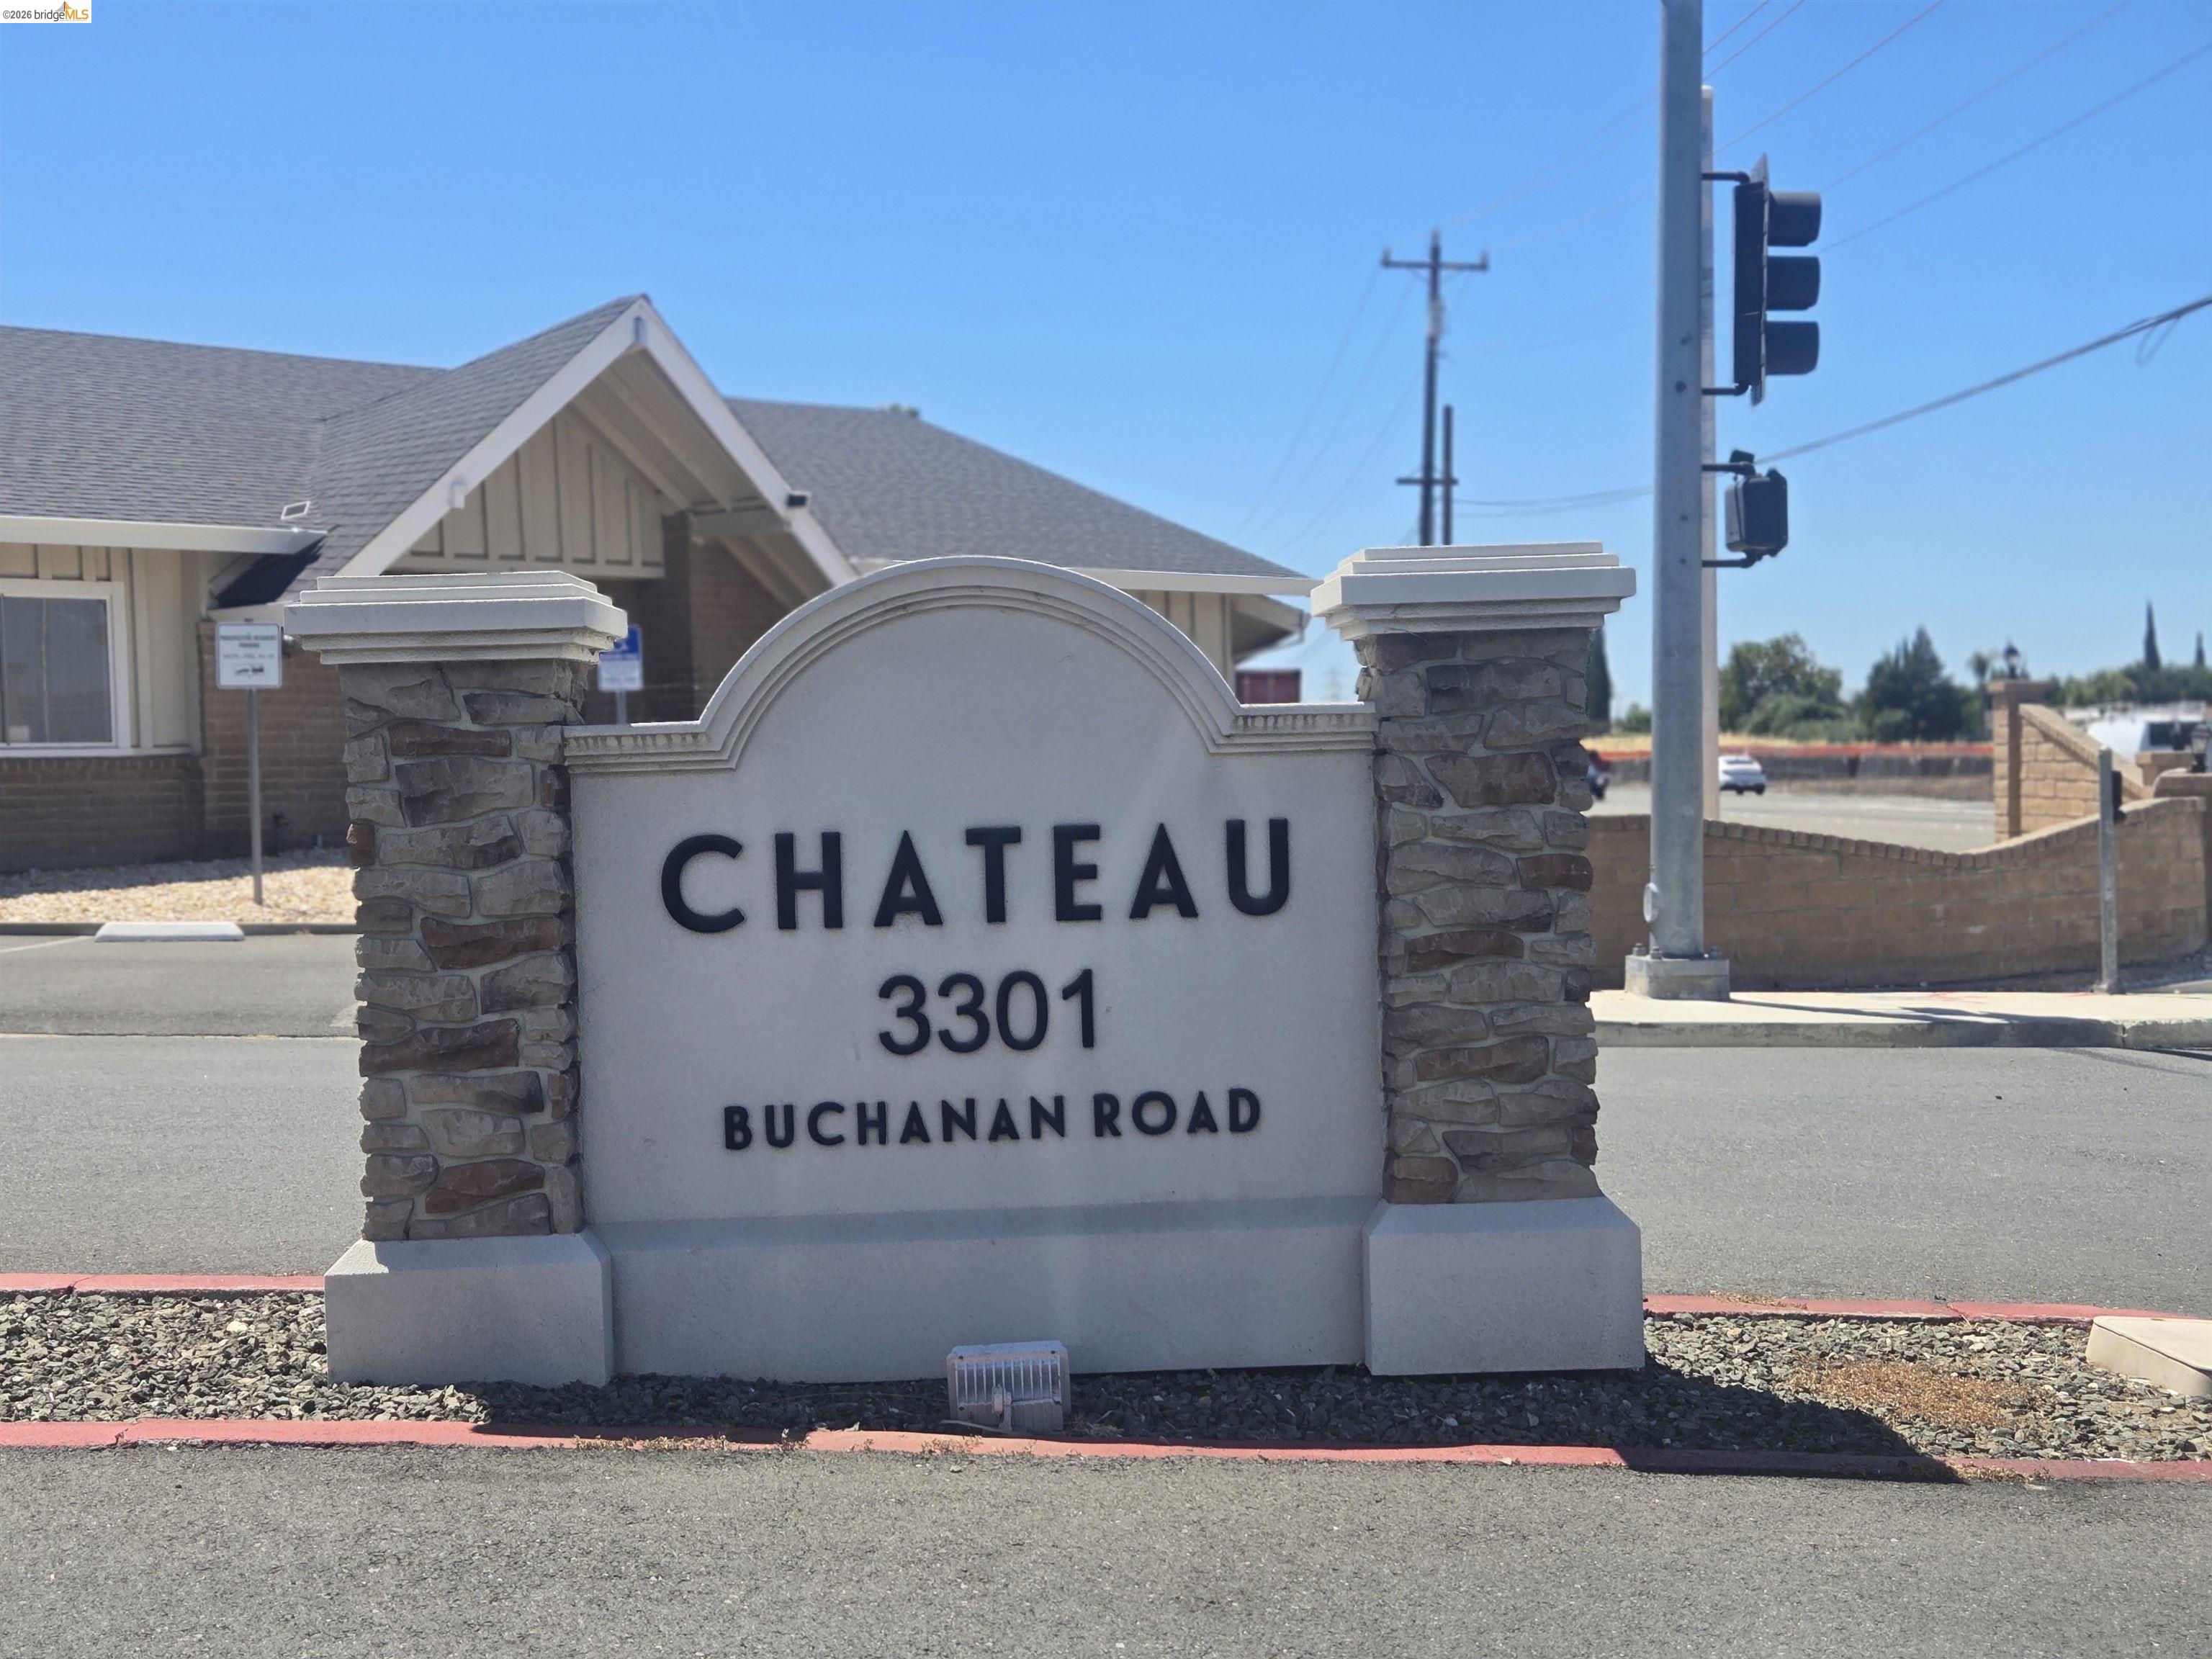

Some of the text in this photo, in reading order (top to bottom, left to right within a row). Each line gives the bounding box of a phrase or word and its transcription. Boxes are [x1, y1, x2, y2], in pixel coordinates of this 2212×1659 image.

[660, 817, 1292, 935] CHATEAU
[878, 968, 1096, 1058] 3301
[723, 1087, 1262, 1153] BUCHANAN ROAD
